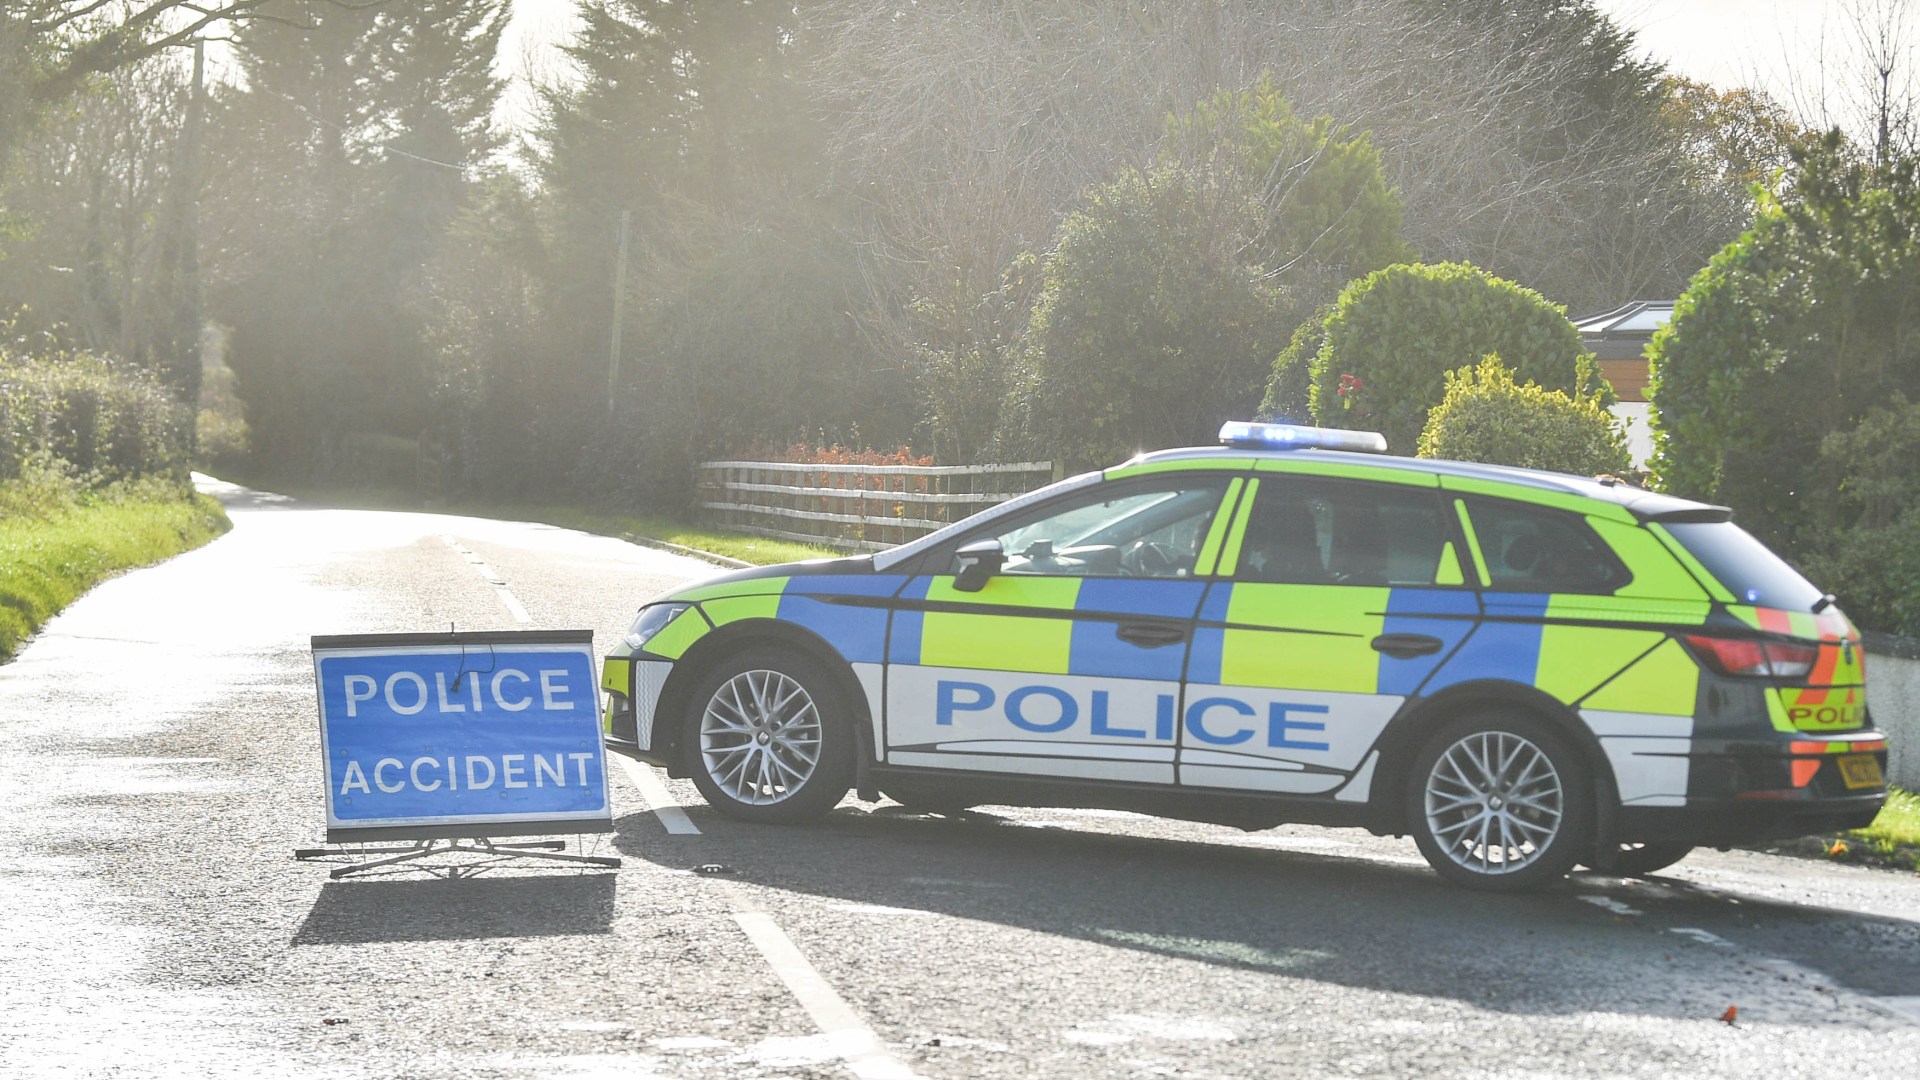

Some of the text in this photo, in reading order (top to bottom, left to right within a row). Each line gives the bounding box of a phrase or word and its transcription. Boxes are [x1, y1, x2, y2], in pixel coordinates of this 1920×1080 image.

[344, 669, 575, 717] POLICE
[936, 680, 1329, 751] POLICE
[340, 753, 594, 795] ACCIDENT
